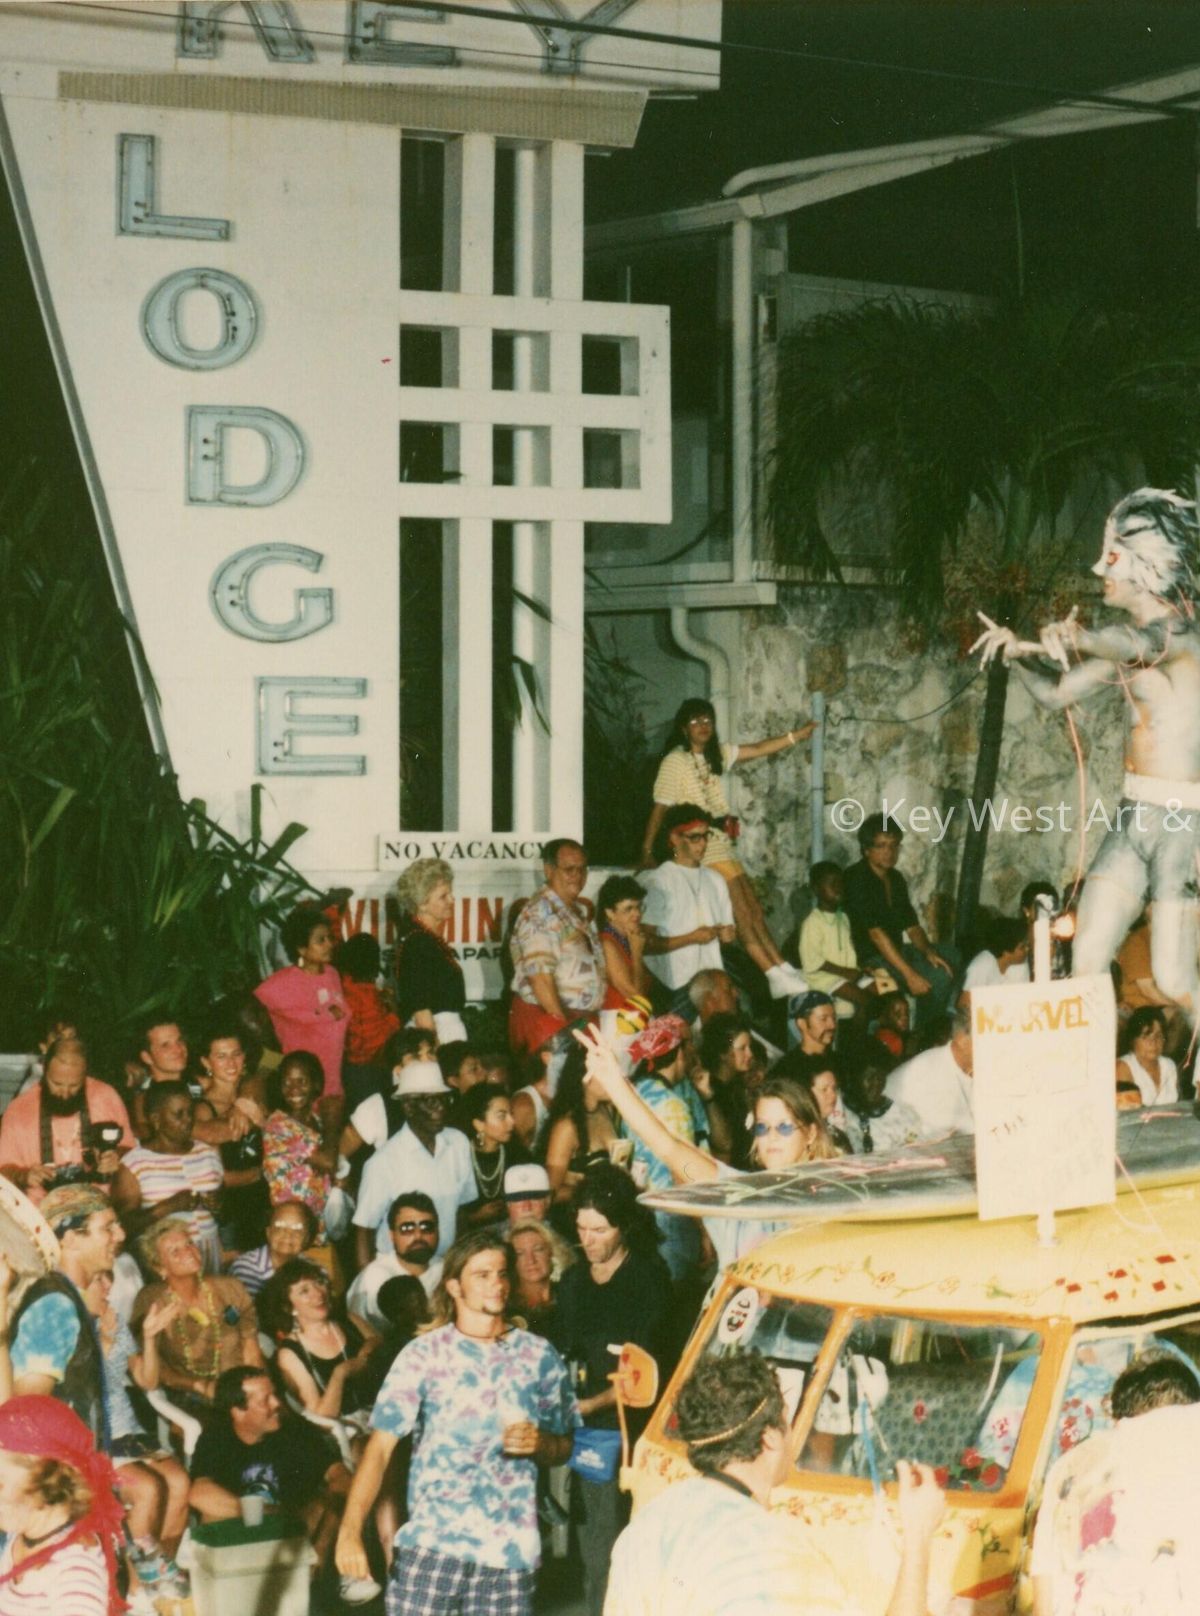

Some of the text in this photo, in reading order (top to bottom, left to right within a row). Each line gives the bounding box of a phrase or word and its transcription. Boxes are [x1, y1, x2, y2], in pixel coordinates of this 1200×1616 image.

[116, 132, 367, 776] LODGE
[384, 841, 421, 860] NO
[976, 995, 1089, 1034] MRVEL
